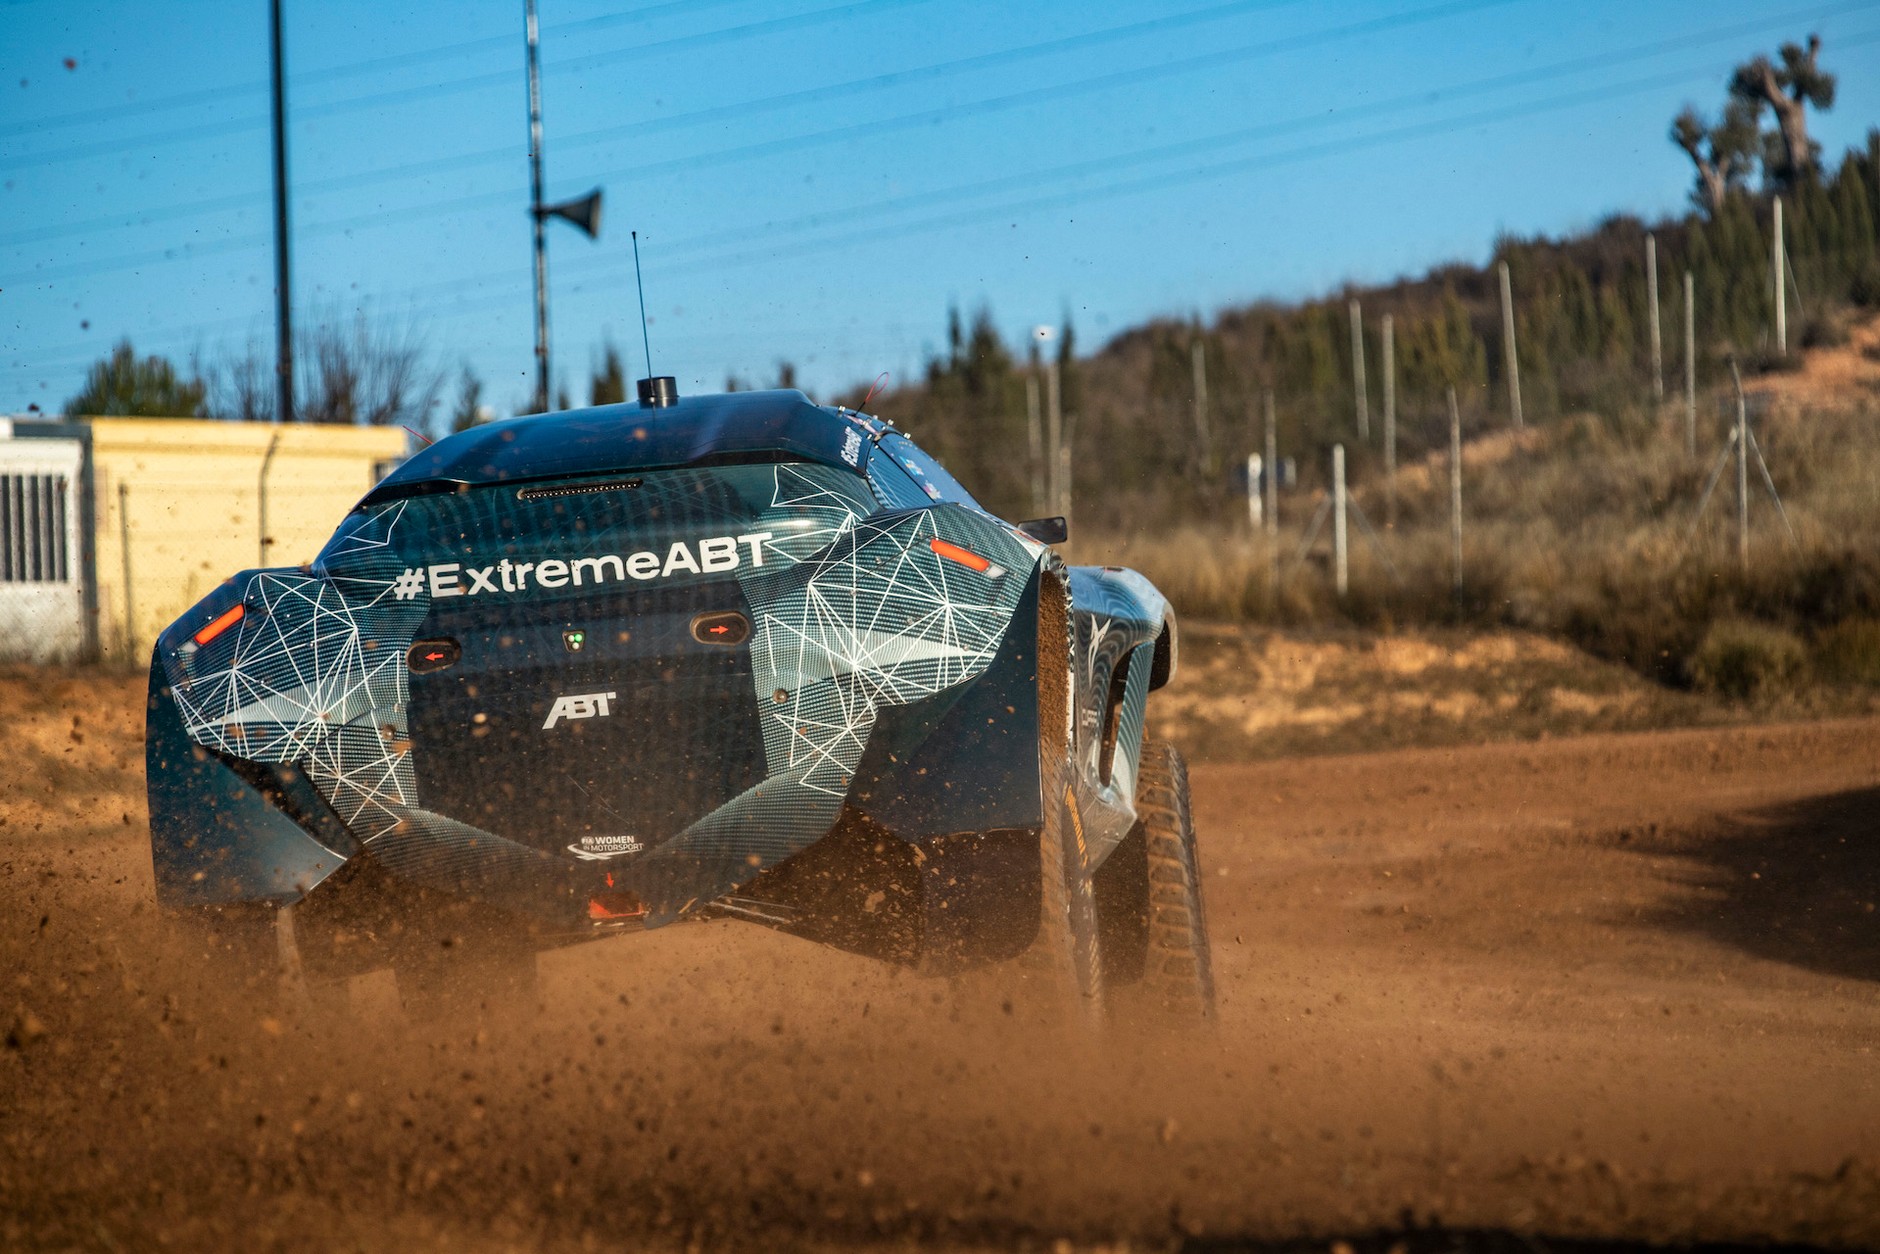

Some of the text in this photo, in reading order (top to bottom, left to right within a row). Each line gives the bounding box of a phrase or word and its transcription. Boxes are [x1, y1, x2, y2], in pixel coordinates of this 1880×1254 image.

[394, 532, 772, 599] #ExtremeABT
[542, 692, 617, 730] ABT
[591, 843, 644, 851] MOTORSPORT
[595, 835, 635, 844] WOMEN
